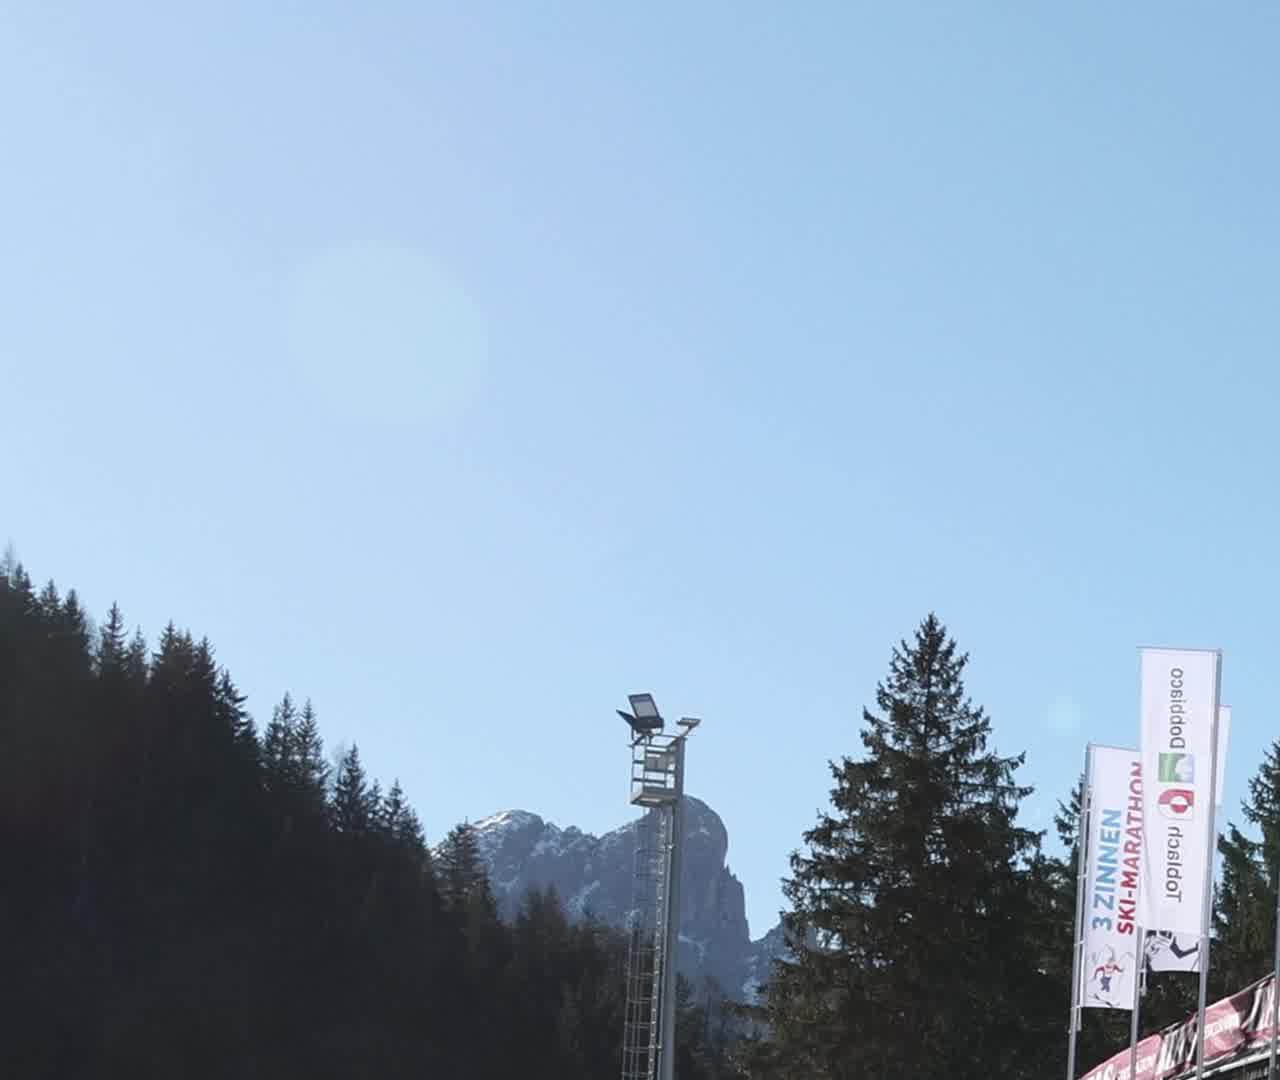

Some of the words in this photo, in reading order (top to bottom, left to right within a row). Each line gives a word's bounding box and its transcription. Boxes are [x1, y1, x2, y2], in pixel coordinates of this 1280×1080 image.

[1094, 808, 1123, 911] ZINNEN
[1117, 761, 1144, 935] SKI-MARATHON
[1093, 915, 1112, 932] 3
